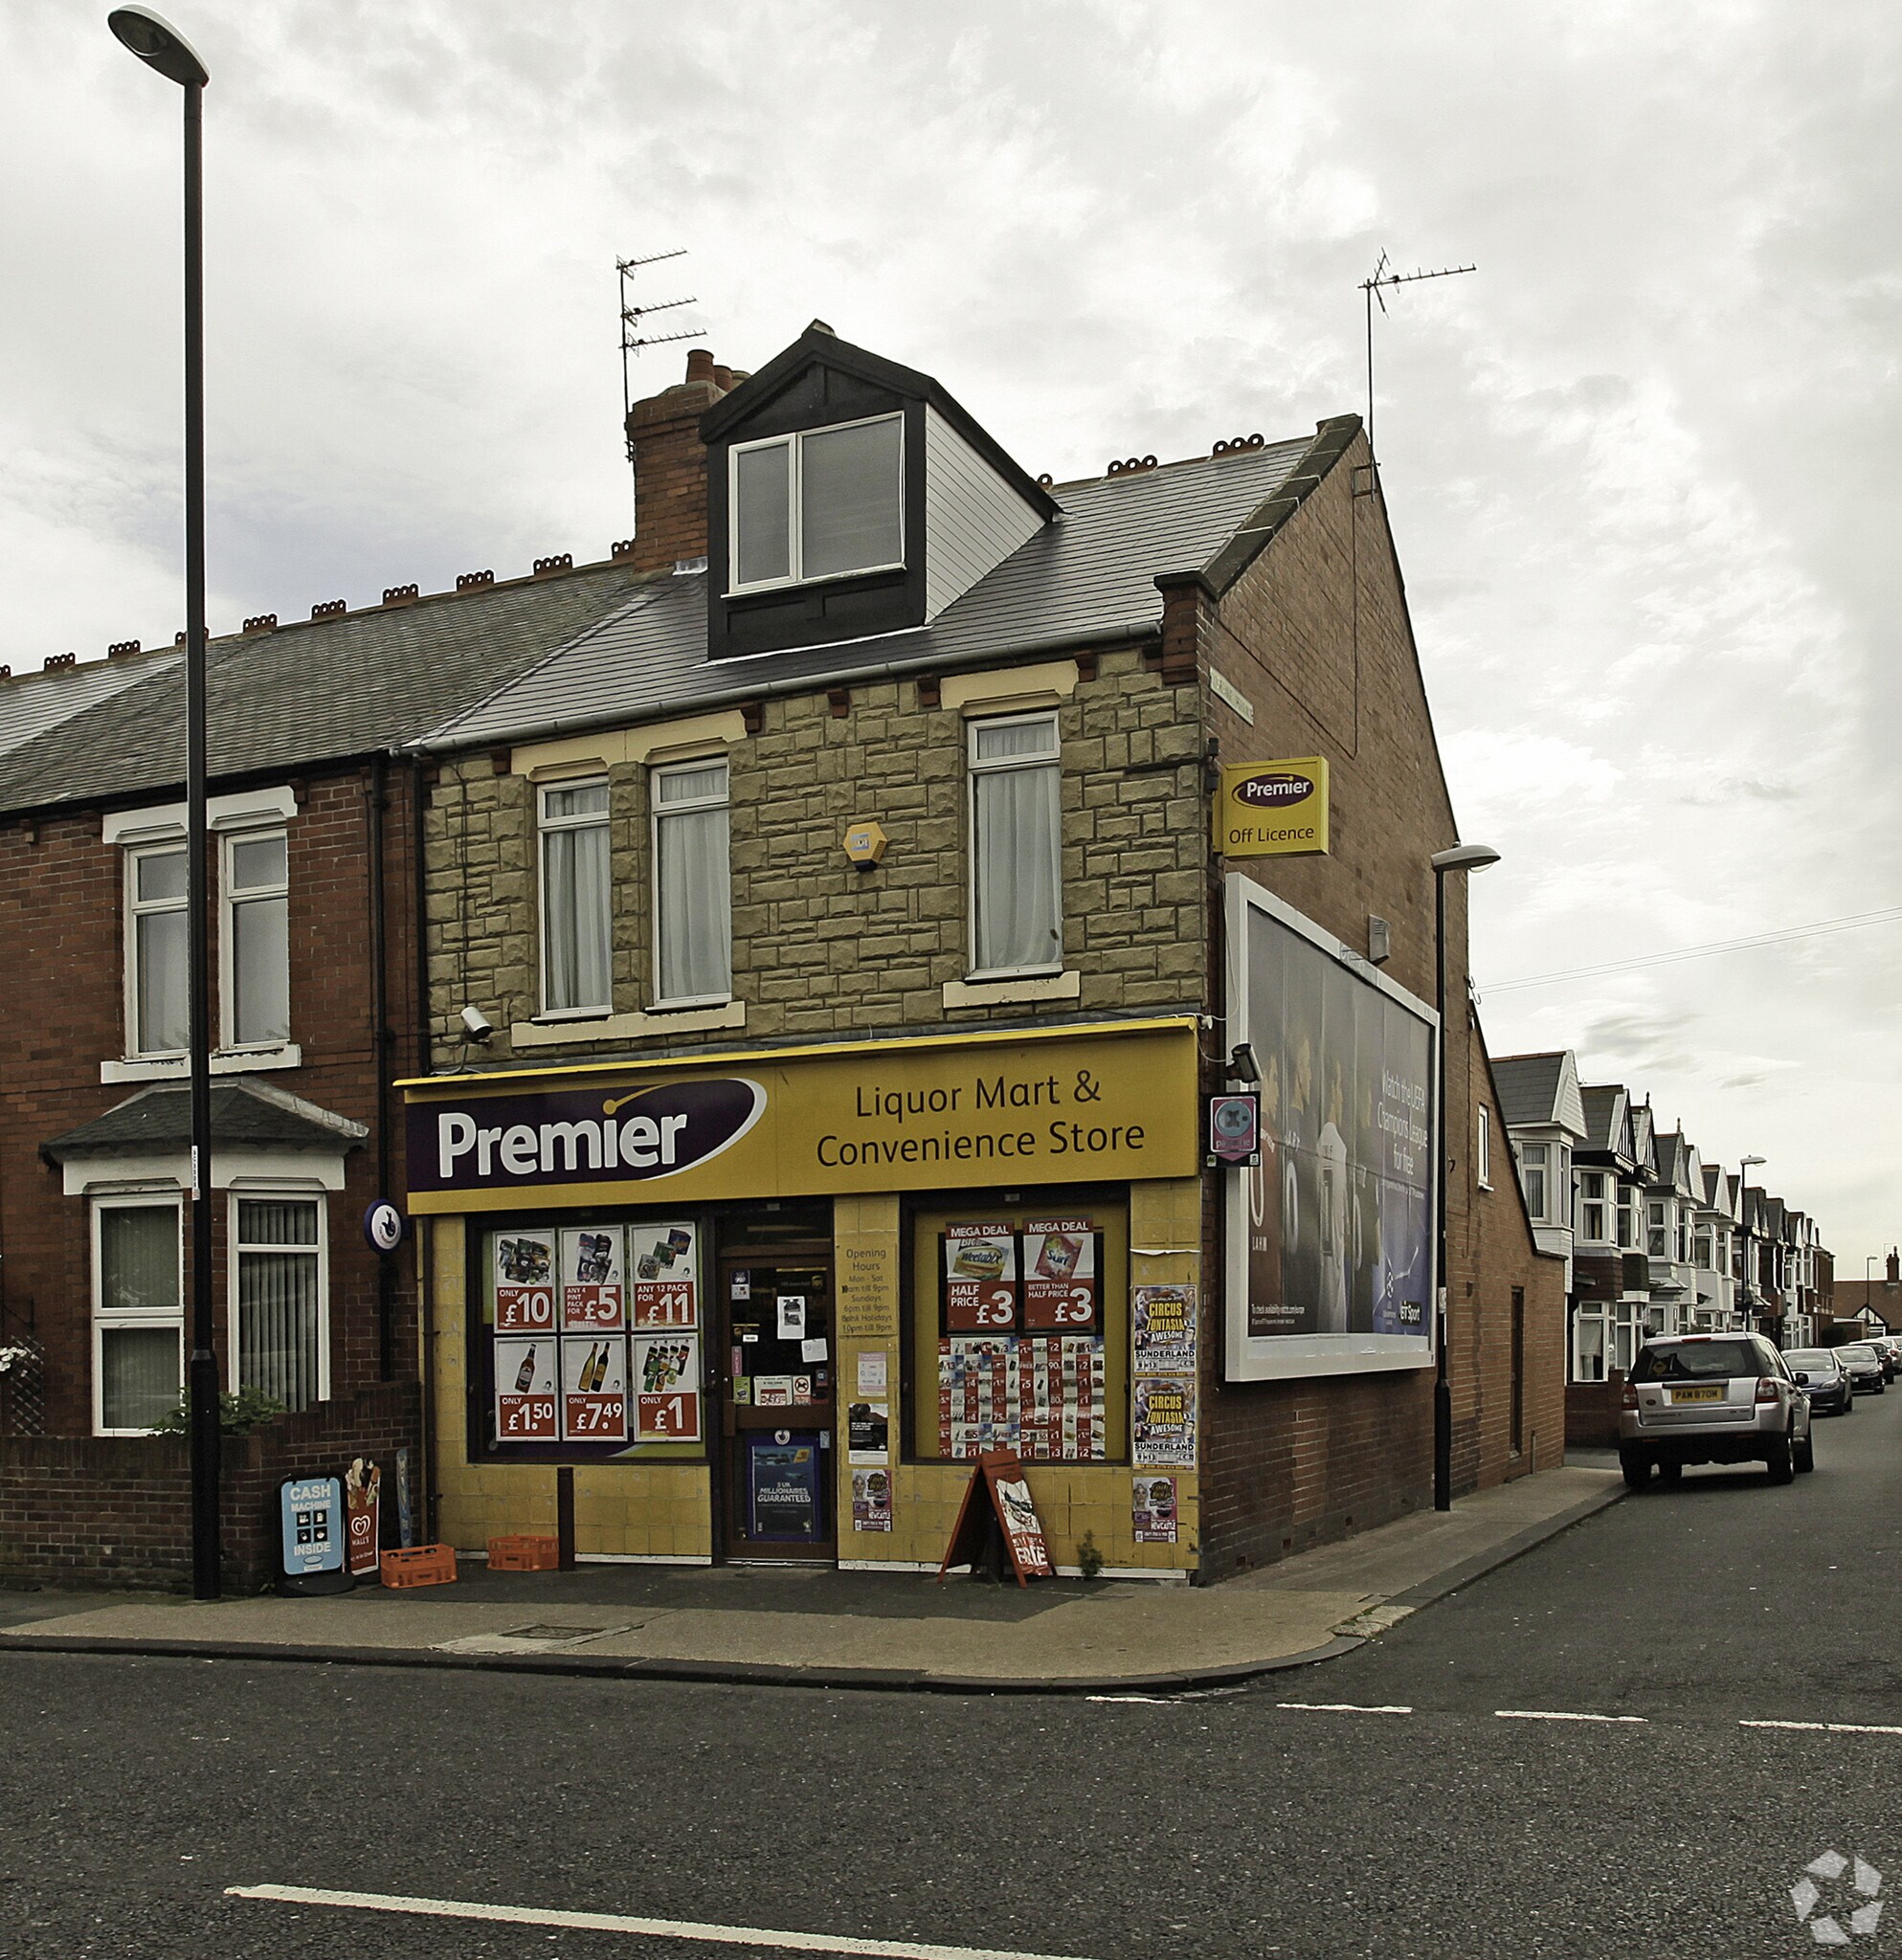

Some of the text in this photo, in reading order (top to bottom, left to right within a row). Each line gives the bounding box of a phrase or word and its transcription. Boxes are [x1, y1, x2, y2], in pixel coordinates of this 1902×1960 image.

[1246, 780, 1310, 798] Premier
[1229, 827, 1315, 844] Off Licence
[856, 1070, 1102, 1124] Liquor Mart &
[437, 1112, 688, 1179] Premier
[817, 1121, 1146, 1168] Convenience Store
[951, 1225, 1009, 1237] MEGA DEAL
[1028, 1221, 1088, 1233] MEGA DEAL
[846, 1249, 886, 1259] Opening
[962, 1251, 1002, 1264] Weetabix
[1047, 1250, 1070, 1266] Surf
[852, 1262, 881, 1271] Hours
[873, 1284, 889, 1293] 9pm
[951, 1285, 979, 1296] HALF
[505, 1292, 549, 1324] £10
[584, 1287, 617, 1321] £5
[647, 1293, 688, 1324] £11
[951, 1297, 979, 1306] PRICE
[976, 1290, 1013, 1324] £3
[1055, 1287, 1092, 1323] £3
[1149, 1303, 1182, 1317] CIRCUS
[1146, 1318, 1185, 1331] FUNTASIA
[1151, 1331, 1184, 1343] AWESOME
[640, 1396, 661, 1405] ONLY
[1149, 1395, 1182, 1410] CIRCUS
[508, 1403, 553, 1430] £1.50
[576, 1403, 622, 1430] £7.49
[655, 1396, 683, 1430] £1
[1146, 1411, 1185, 1424] FUNTASIA
[1151, 1424, 1183, 1436] AWESOME
[290, 1484, 331, 1502] CASH
[757, 1494, 812, 1503] GUARANTEED
[291, 1500, 332, 1512] MACHINE
[294, 1542, 332, 1557] INSIDE
